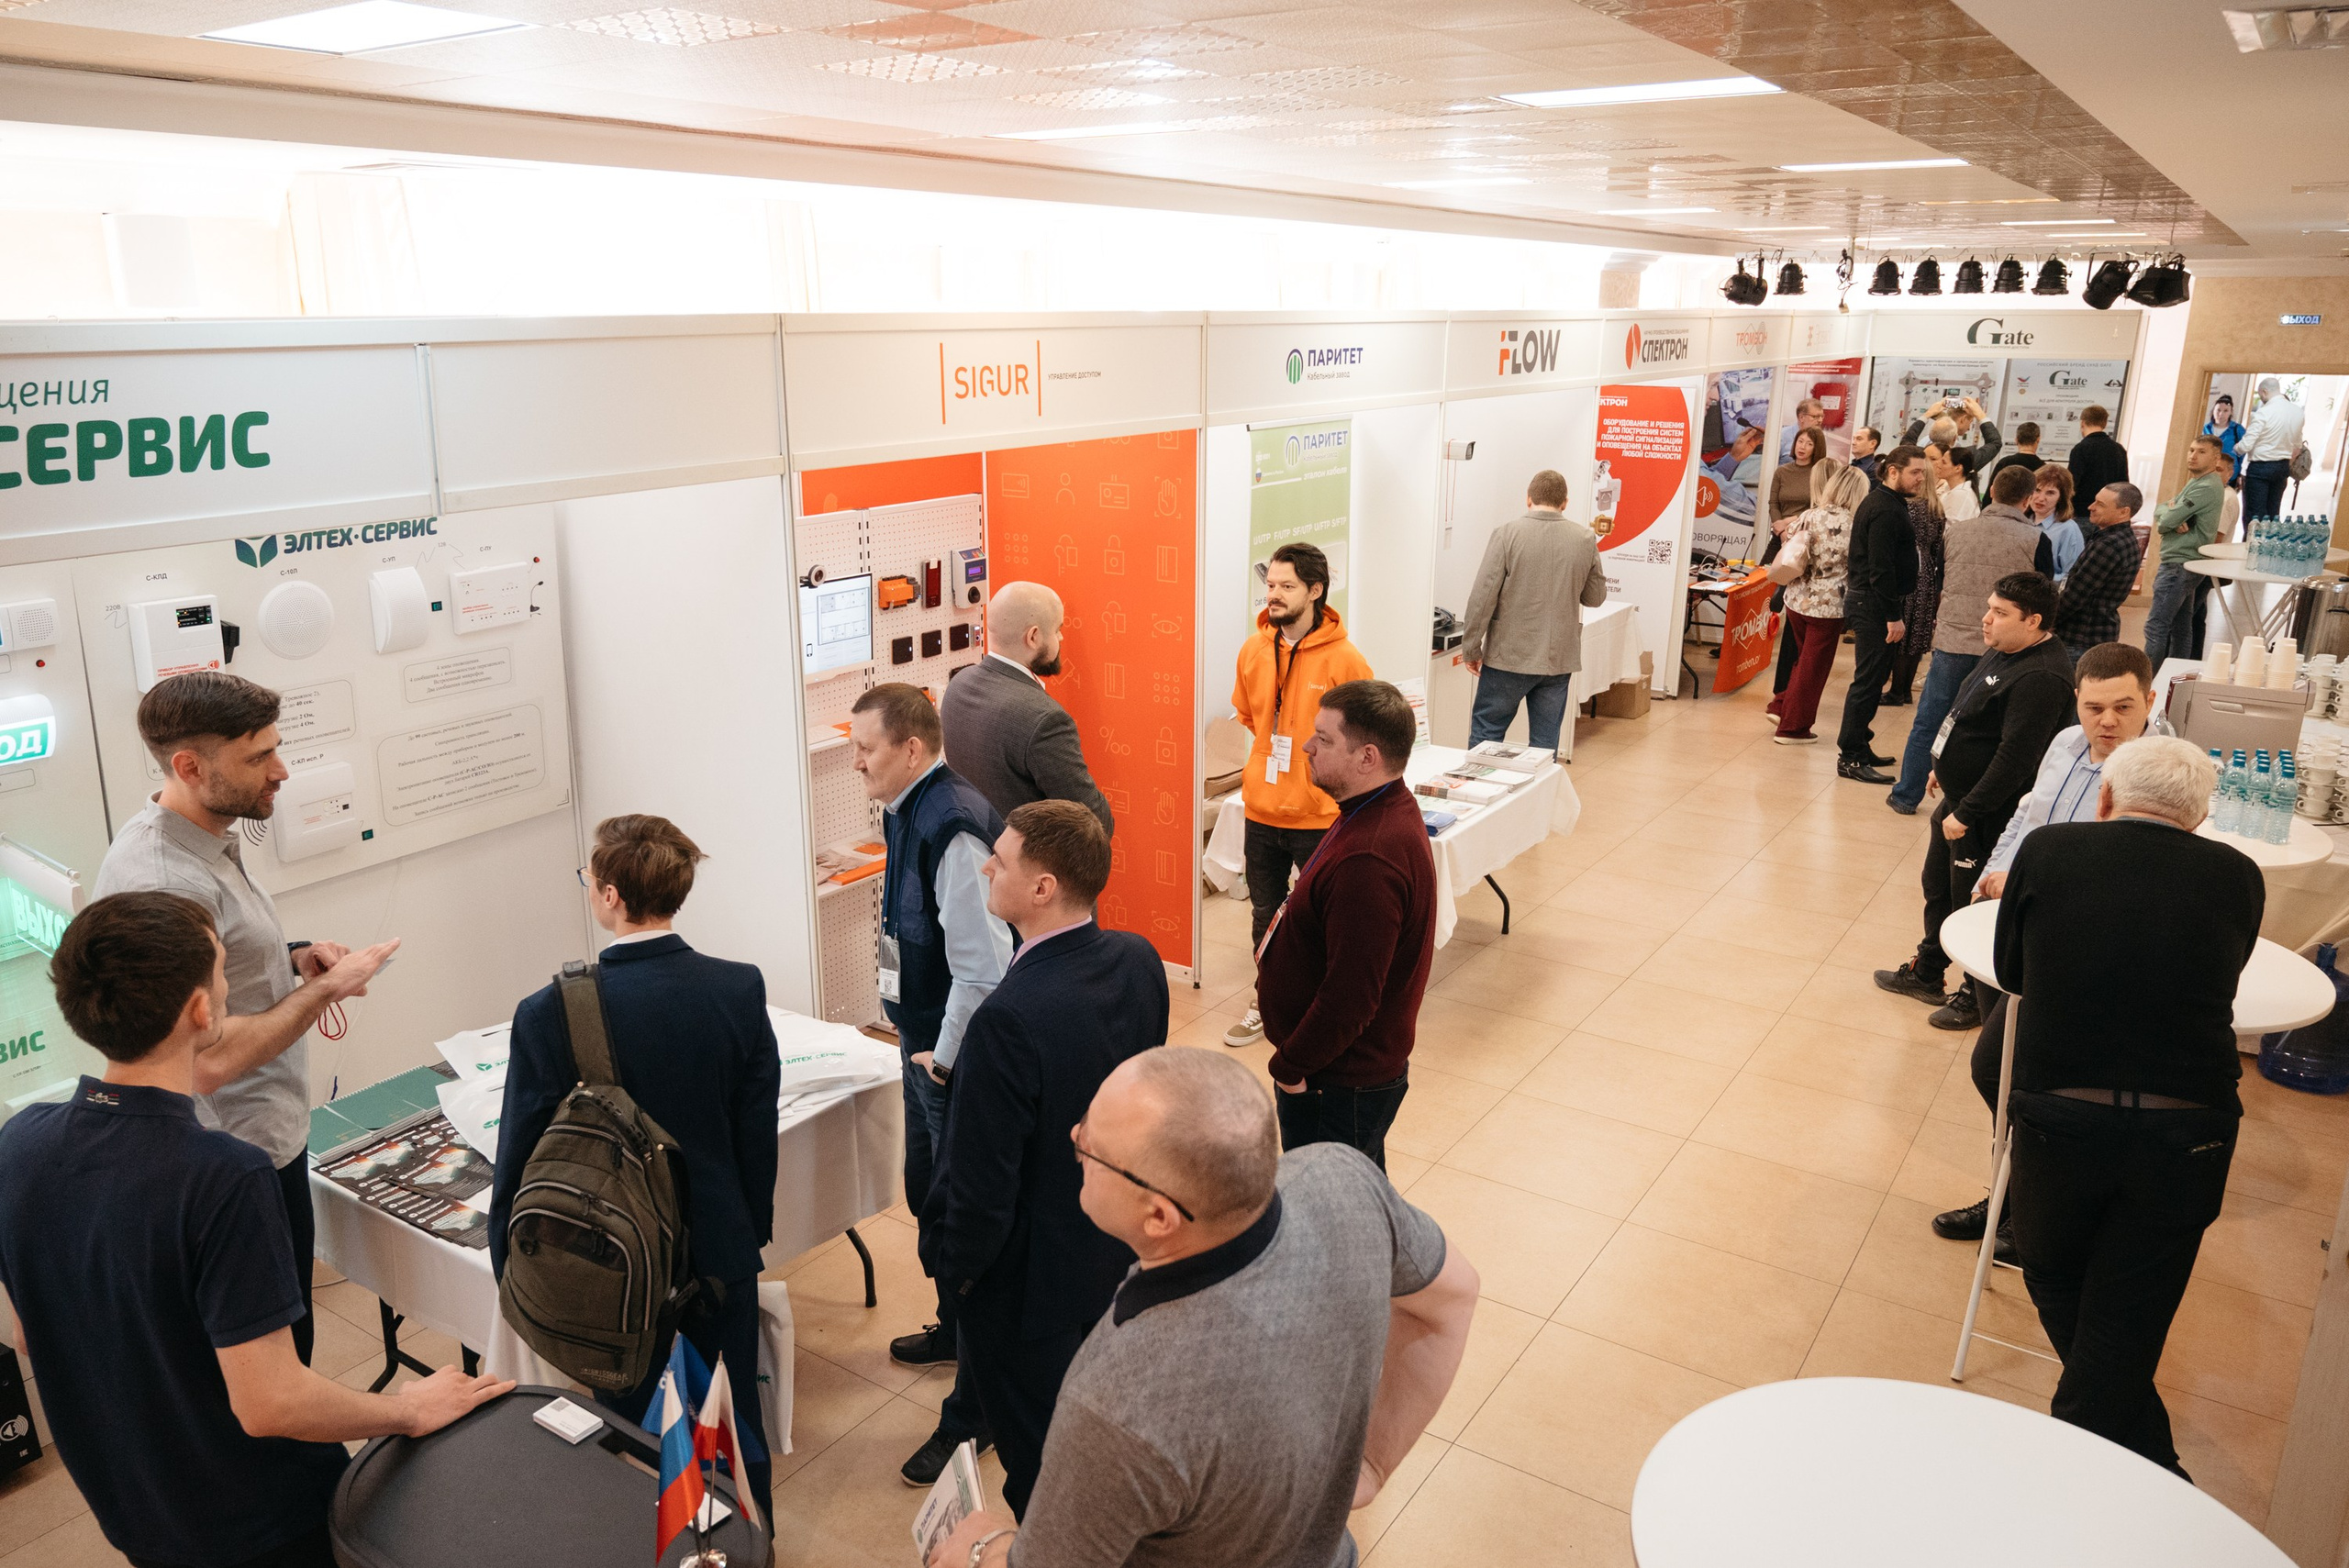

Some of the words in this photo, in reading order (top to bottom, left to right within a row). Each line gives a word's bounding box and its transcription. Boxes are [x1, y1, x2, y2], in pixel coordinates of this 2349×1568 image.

[1736, 331, 1768, 347] ТРОМБОН
[1967, 317, 2034, 346] Gate
[1308, 347, 1364, 367] ПАРИТЕТ
[1642, 338, 1688, 362] СПЕКТРОН
[954, 364, 1030, 399] SIGUR
[1048, 372, 1077, 380] УПРАВЛЕНИЕ
[1077, 371, 1101, 379] ДОСТУПОМ
[1307, 370, 1335, 381] Кабельный
[2049, 370, 2087, 385] Gate
[1599, 398, 1628, 406] КТРОН
[1603, 418, 1649, 428] ОБОРУДОВАНИЕ
[1607, 426, 1620, 434] ДЛЯ
[1621, 428, 1659, 436] ПОСТРОЕНИЯ
[1303, 430, 1348, 450] ПАРИТЕТ
[1601, 433, 1634, 442] ПОЖАРНОЙ
[1635, 436, 1683, 445] СИГНАЛИЗАЦИИ
[1602, 441, 1642, 450] ОПОВЕЩЕНИЯ
[1652, 444, 1682, 452] ОБЪЕКТАХ
[1621, 450, 1643, 458] ЛЮБОЙ
[1274, 528, 1290, 541] F/UTP
[1292, 523, 1312, 537] SF/UTP
[1330, 517, 1347, 528] S/FTP
[106, 604, 121, 612] 220В
[1731, 611, 1772, 647] ТРОМБО
[1954, 860, 1973, 868] PUMA
[11, 887, 72, 951] ВЫХО
[920, 1497, 938, 1530] ПАРИТЕТ
